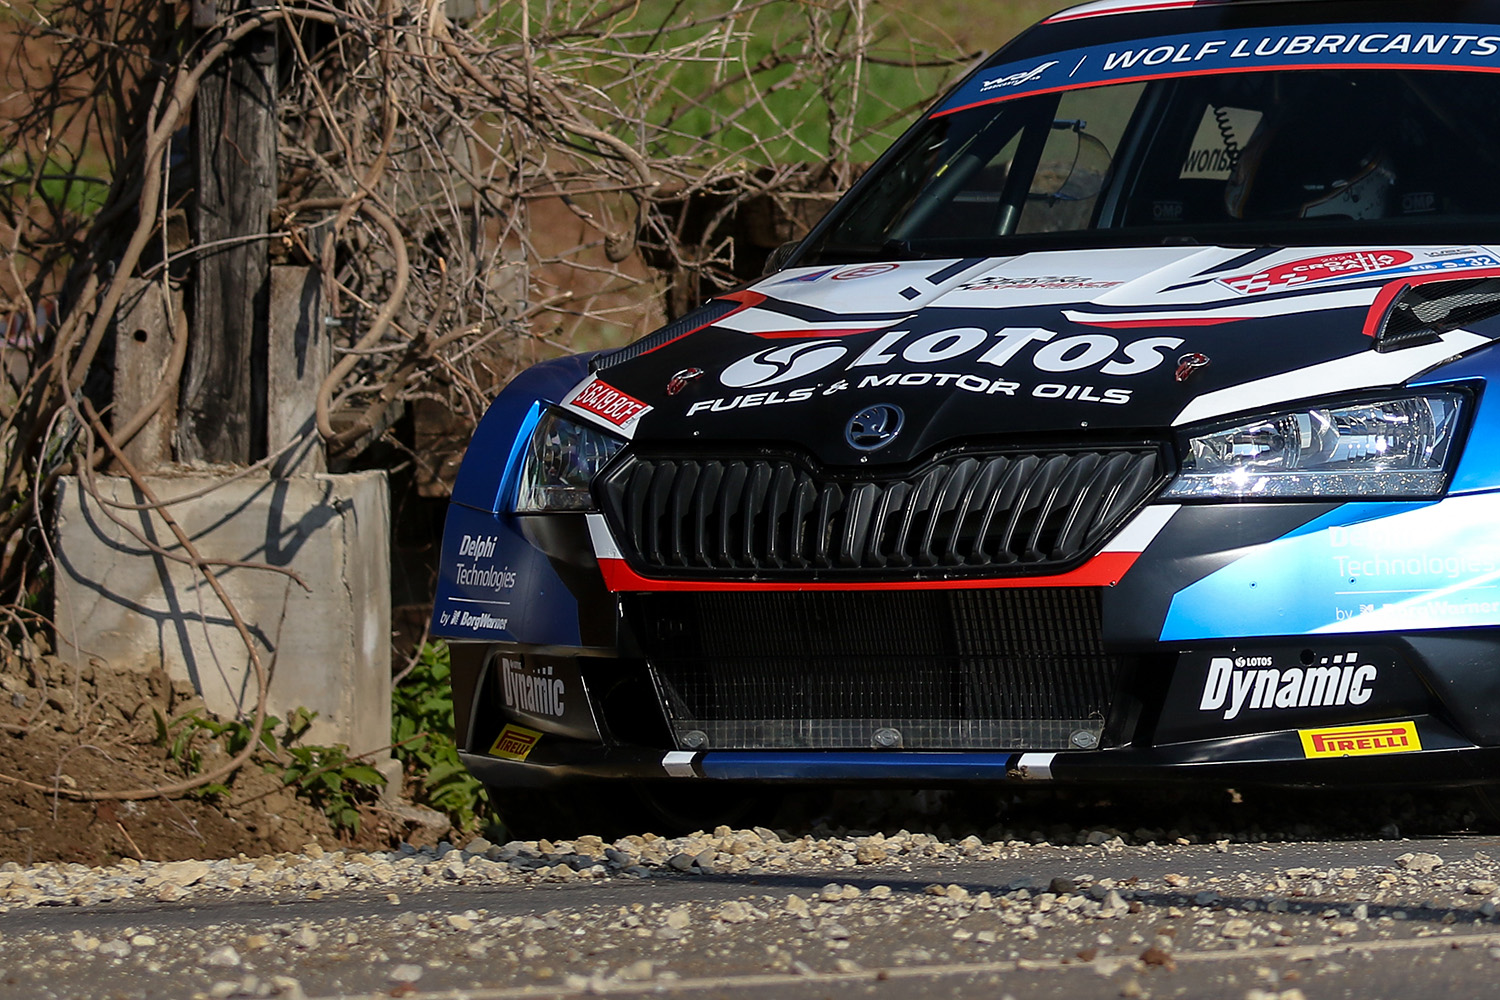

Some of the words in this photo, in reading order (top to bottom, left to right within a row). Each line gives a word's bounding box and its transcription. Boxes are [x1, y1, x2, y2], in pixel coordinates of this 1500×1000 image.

[1102, 41, 1227, 71] WOLF
[1465, 256, 1497, 267] 32
[846, 327, 1186, 375] LOTOS
[686, 386, 817, 417] FUELS
[822, 379, 850, 396] &
[857, 372, 1021, 396] MOTOR
[1032, 383, 1134, 405] OILS
[459, 534, 498, 561] Delphi
[456, 563, 516, 592] Technologies
[1332, 553, 1496, 578] Technologies
[440, 610, 451, 627] by
[460, 611, 508, 631] BorgWarner
[1335, 607, 1353, 621] by
[1246, 656, 1272, 667] LOTOS
[502, 657, 565, 717] Dynamic
[1200, 652, 1377, 720] Dynamic
[496, 729, 536, 756] PIRELLI
[1311, 727, 1409, 753] PIRELLI
